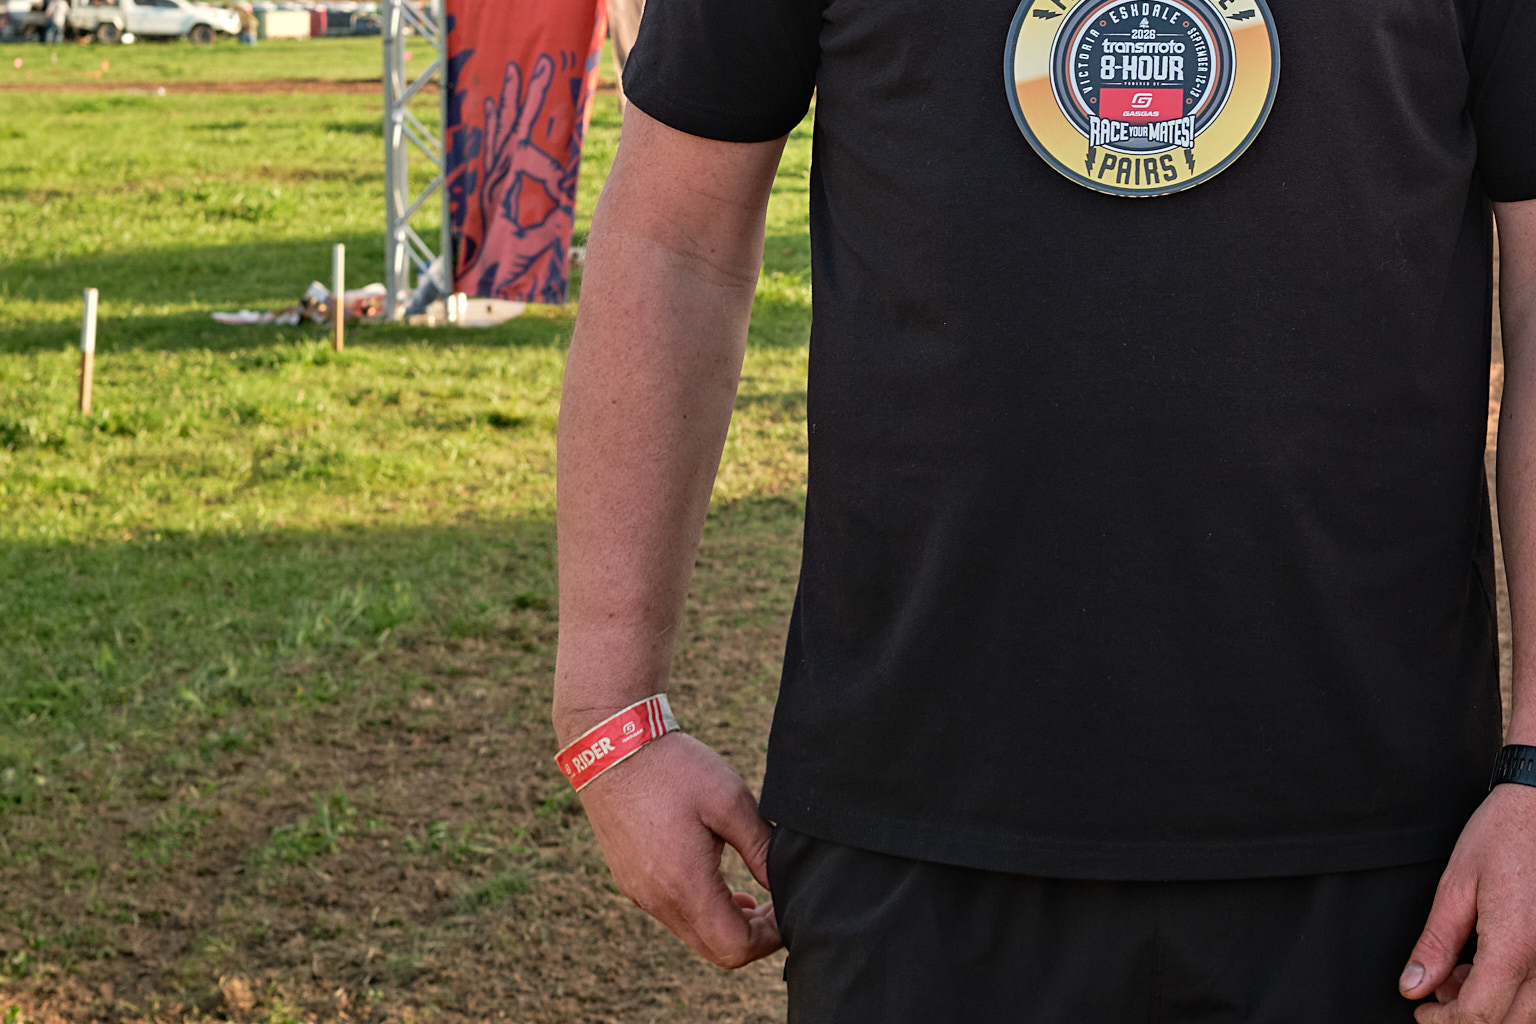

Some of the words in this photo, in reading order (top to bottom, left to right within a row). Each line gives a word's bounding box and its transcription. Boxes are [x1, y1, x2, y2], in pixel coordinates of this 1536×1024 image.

[1101, 37, 1186, 54] transmoto
[1131, 29, 1156, 40] 2026
[1187, 27, 1209, 72] SEPTEMBER
[1078, 28, 1100, 94] VICTORIA
[1100, 55, 1184, 81] 8-HOUR
[1189, 74, 1207, 98] 12-13
[1089, 115, 1129, 147] RACE
[1128, 126, 1148, 137] YOUR
[1148, 115, 1195, 148] MATES!
[1097, 153, 1178, 185] PAIRS
[572, 737, 615, 773] RIDER
